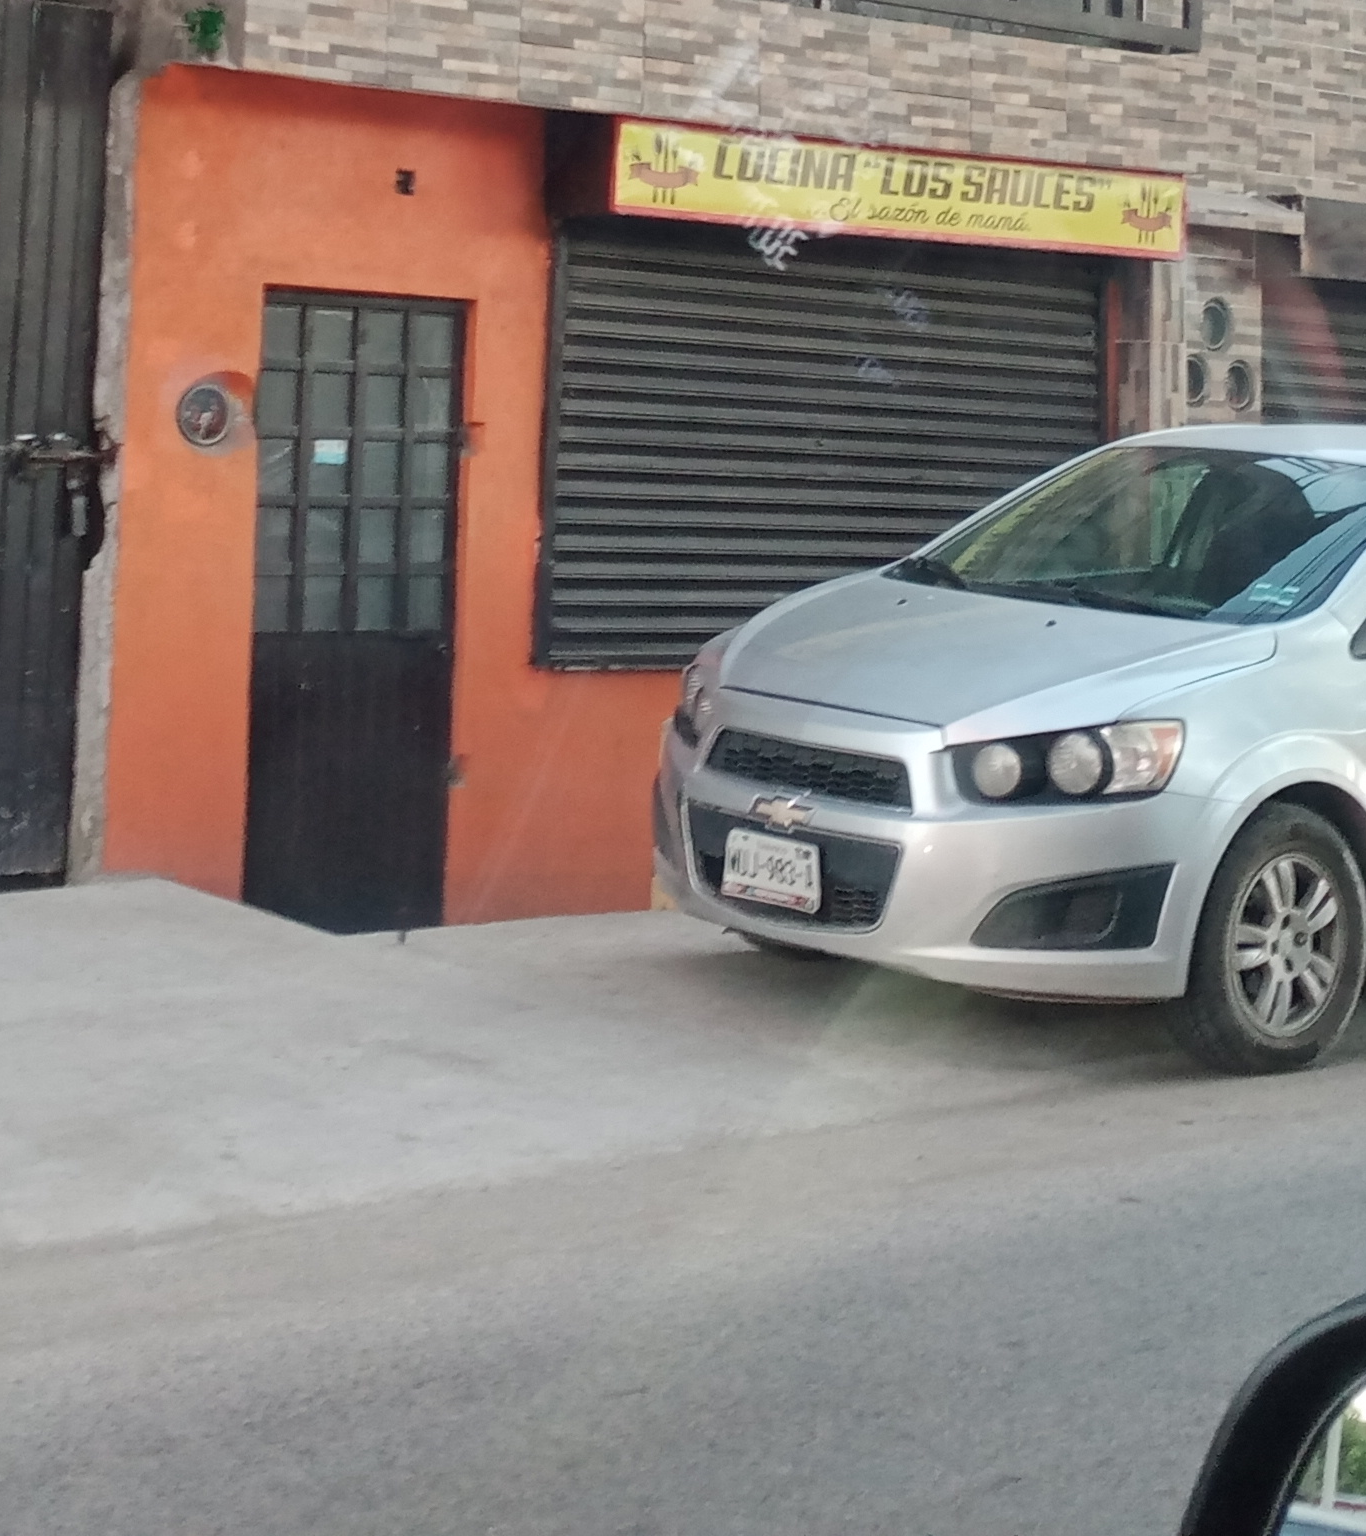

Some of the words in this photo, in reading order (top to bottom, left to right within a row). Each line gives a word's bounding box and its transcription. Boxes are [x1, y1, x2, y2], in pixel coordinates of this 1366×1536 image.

[713, 137, 857, 192] COCINA
[829, 197, 863, 223] El
[867, 203, 930, 224] sazón
[934, 204, 962, 227] de
